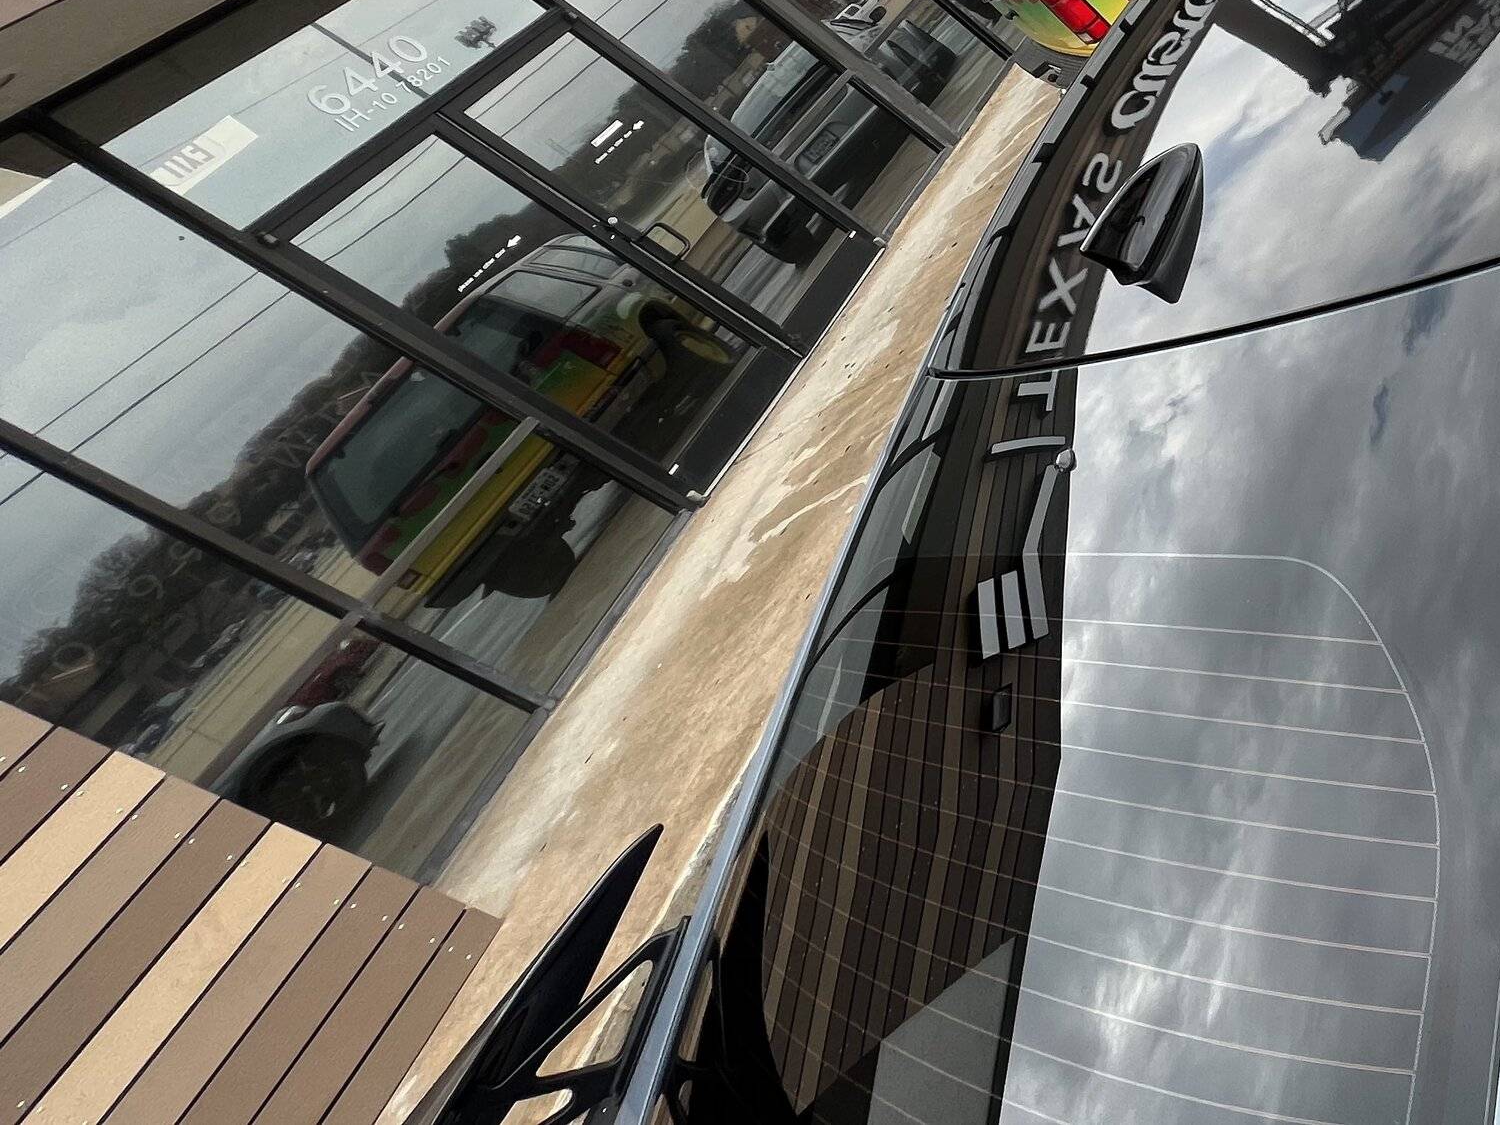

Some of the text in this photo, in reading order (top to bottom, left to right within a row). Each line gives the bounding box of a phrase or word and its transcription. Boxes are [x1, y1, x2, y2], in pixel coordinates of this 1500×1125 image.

[307, 35, 428, 116] 6440
[334, 55, 451, 132] IH-10 78201
